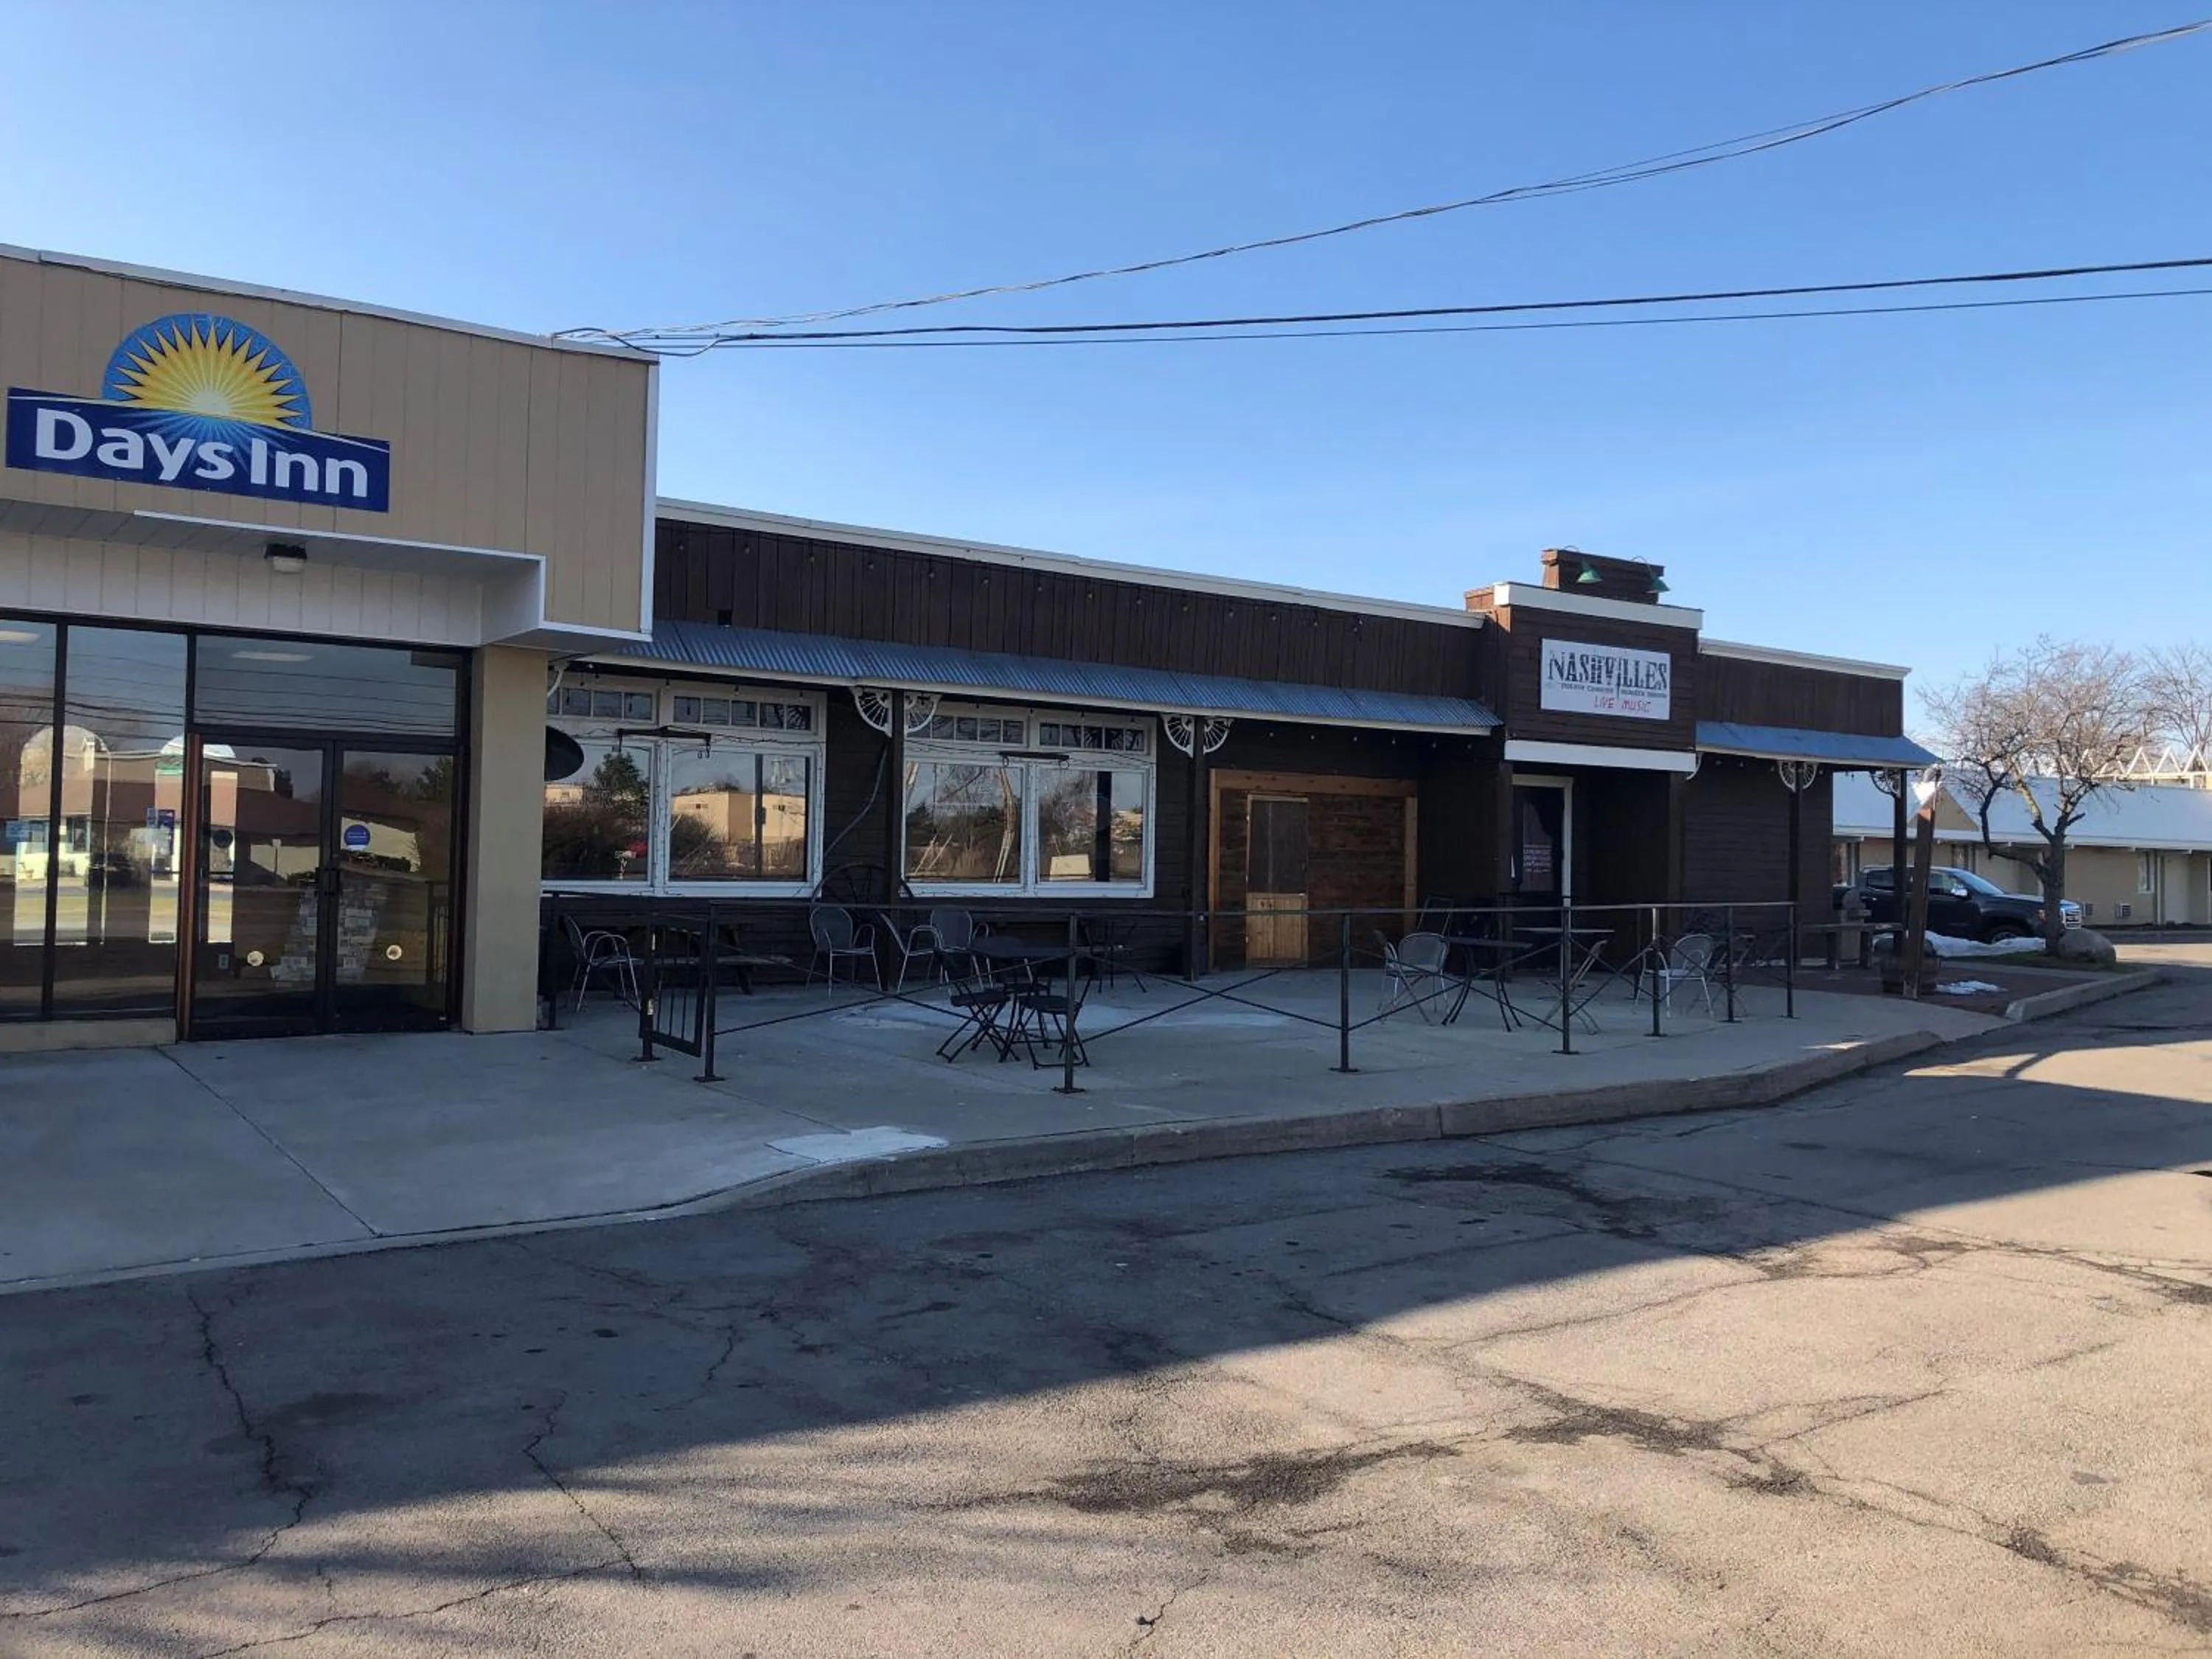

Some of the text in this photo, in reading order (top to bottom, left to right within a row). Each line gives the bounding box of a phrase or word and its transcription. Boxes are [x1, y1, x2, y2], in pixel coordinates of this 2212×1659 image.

[35, 407, 369, 498] Days Inn
[1548, 651, 1668, 692] NASHVILLES
[1593, 695, 1652, 714] LIVE MUSIC
